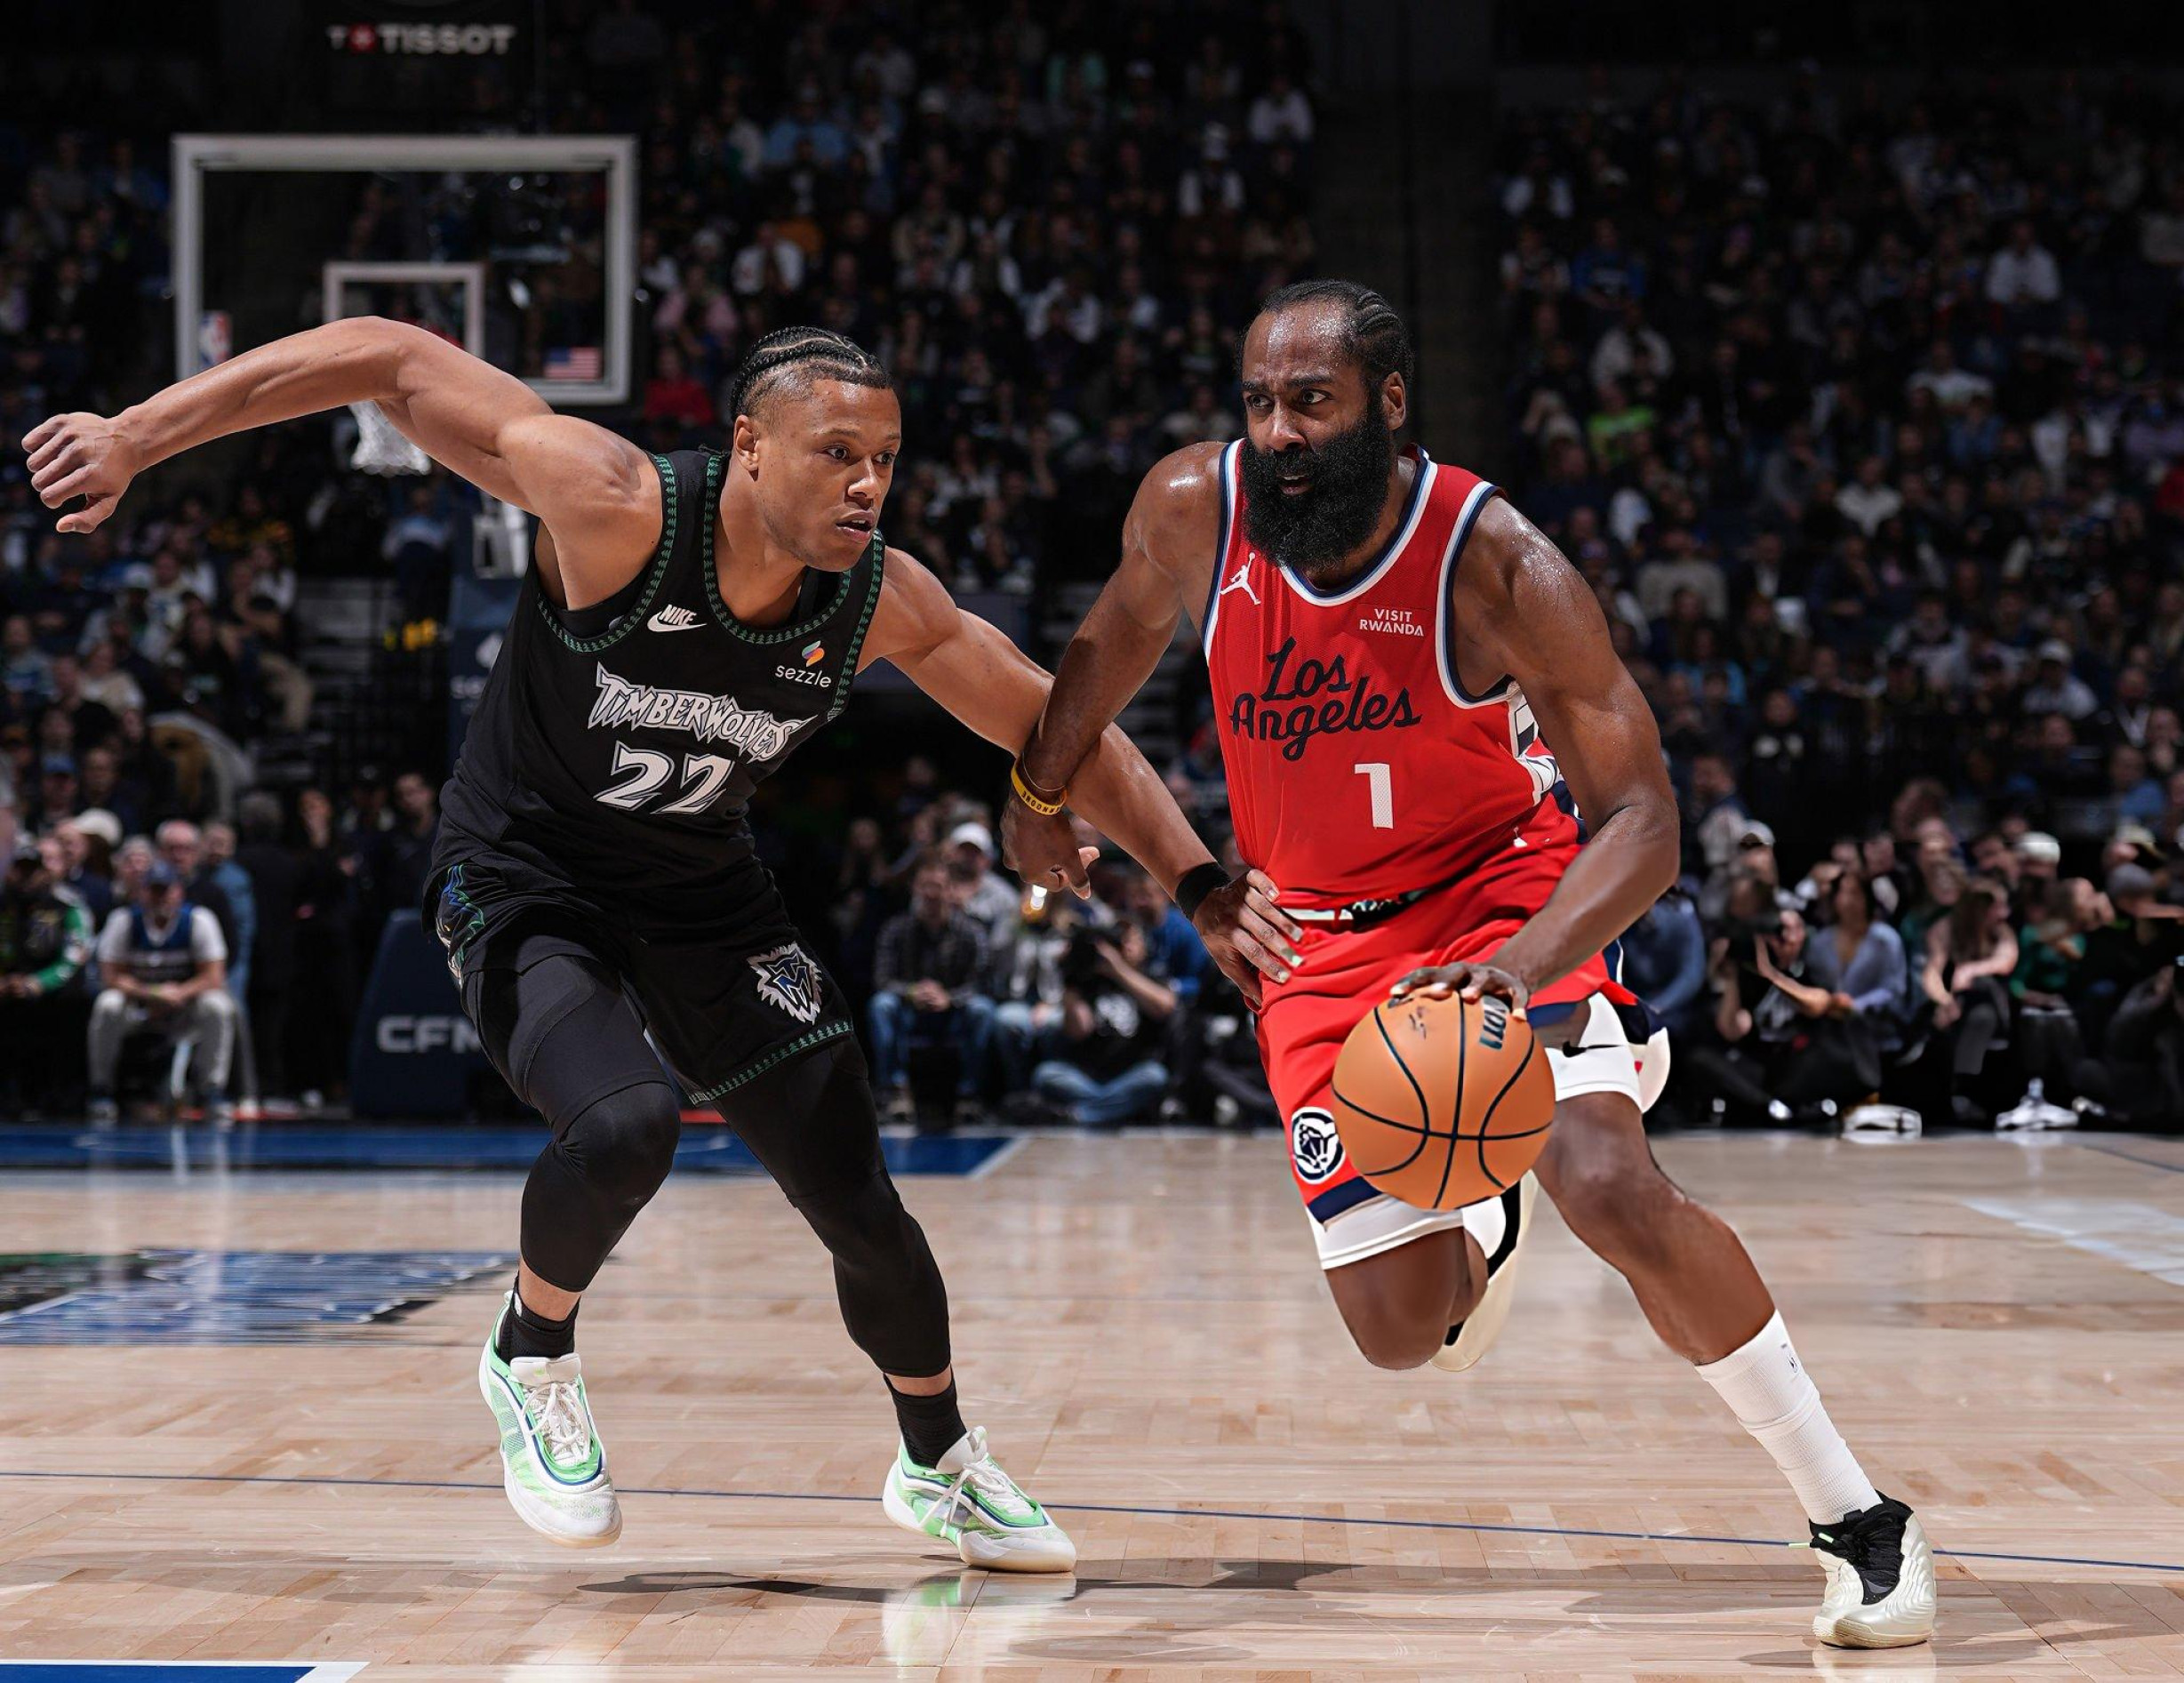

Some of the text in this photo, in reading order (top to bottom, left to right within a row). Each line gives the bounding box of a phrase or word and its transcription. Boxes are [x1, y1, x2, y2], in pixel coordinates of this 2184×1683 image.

[378, 24, 517, 54] TISSOT
[660, 605, 698, 625] NIKE
[1359, 619, 1424, 637] RWANDA
[1374, 608, 1412, 622] VISIT
[775, 665, 832, 688] sezzle
[1260, 637, 1352, 701] Los
[1230, 676, 1422, 761] Angeles
[593, 741, 736, 814] 22
[1355, 763, 1394, 829] 1
